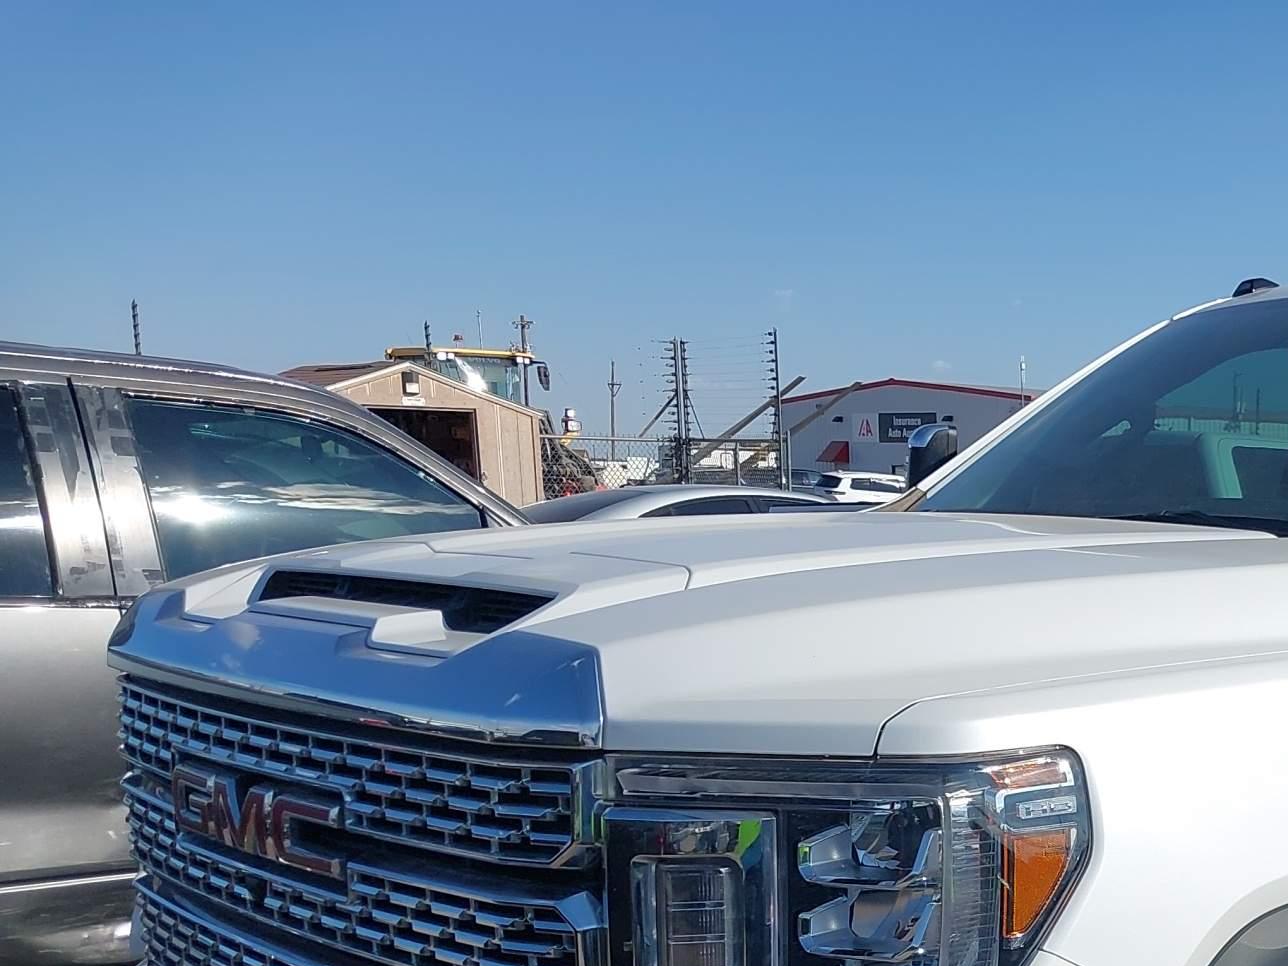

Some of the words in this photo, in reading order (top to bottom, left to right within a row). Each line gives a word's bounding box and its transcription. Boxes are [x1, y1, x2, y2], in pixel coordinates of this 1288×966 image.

[893, 415, 921, 426] Insurance
[888, 428, 901, 438] Auto
[171, 760, 346, 880] GMC
